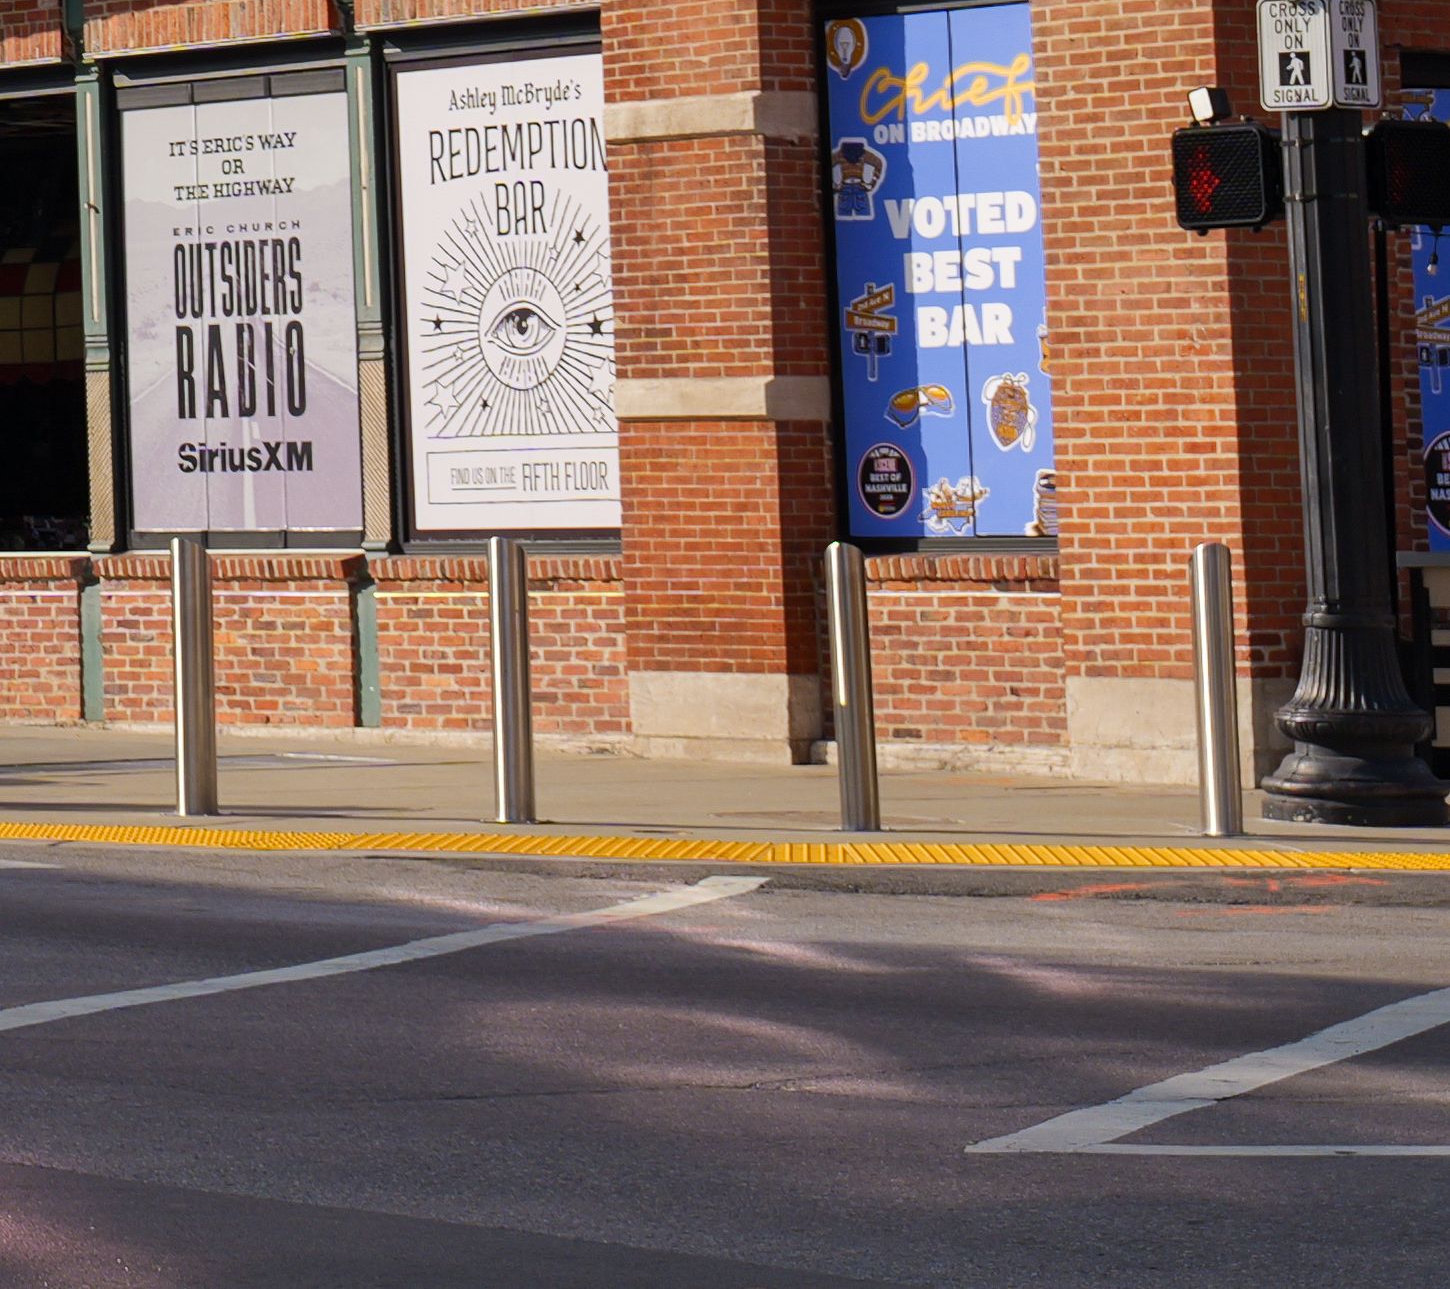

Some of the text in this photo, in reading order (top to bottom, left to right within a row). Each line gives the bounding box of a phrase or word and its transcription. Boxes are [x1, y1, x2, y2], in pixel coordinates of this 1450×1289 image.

[1268, 1, 1316, 19] CROSS
[1339, 0, 1366, 18] CROSS
[1274, 19, 1311, 35] ONLY
[1341, 16, 1364, 34] ONLY
[1284, 35, 1305, 50] ON
[1347, 34, 1360, 49] ON
[447, 79, 583, 115] Ashley McBryde's
[1272, 88, 1319, 104] SIGNAL
[1343, 87, 1371, 102] SIGNAL
[873, 111, 1038, 145] ON BROADWAY
[201, 133, 255, 156] ERIC'S
[258, 131, 298, 152] WAY
[428, 116, 609, 186] REDEMPTION
[220, 157, 245, 175] OR
[174, 177, 296, 202] THE HIGHWAY
[495, 179, 549, 237] BAR
[882, 189, 1038, 240] VOTED
[172, 219, 302, 237] ERIC CHURCH
[173, 236, 304, 320] OUTSIDERS
[903, 246, 1023, 294] BEST
[916, 302, 1015, 348] BAR
[177, 320, 307, 420] RADIO
[177, 440, 314, 475] SiriusXM
[450, 460, 610, 491] FIND US ON THE FLOOR
[869, 473, 889, 482] BEST
